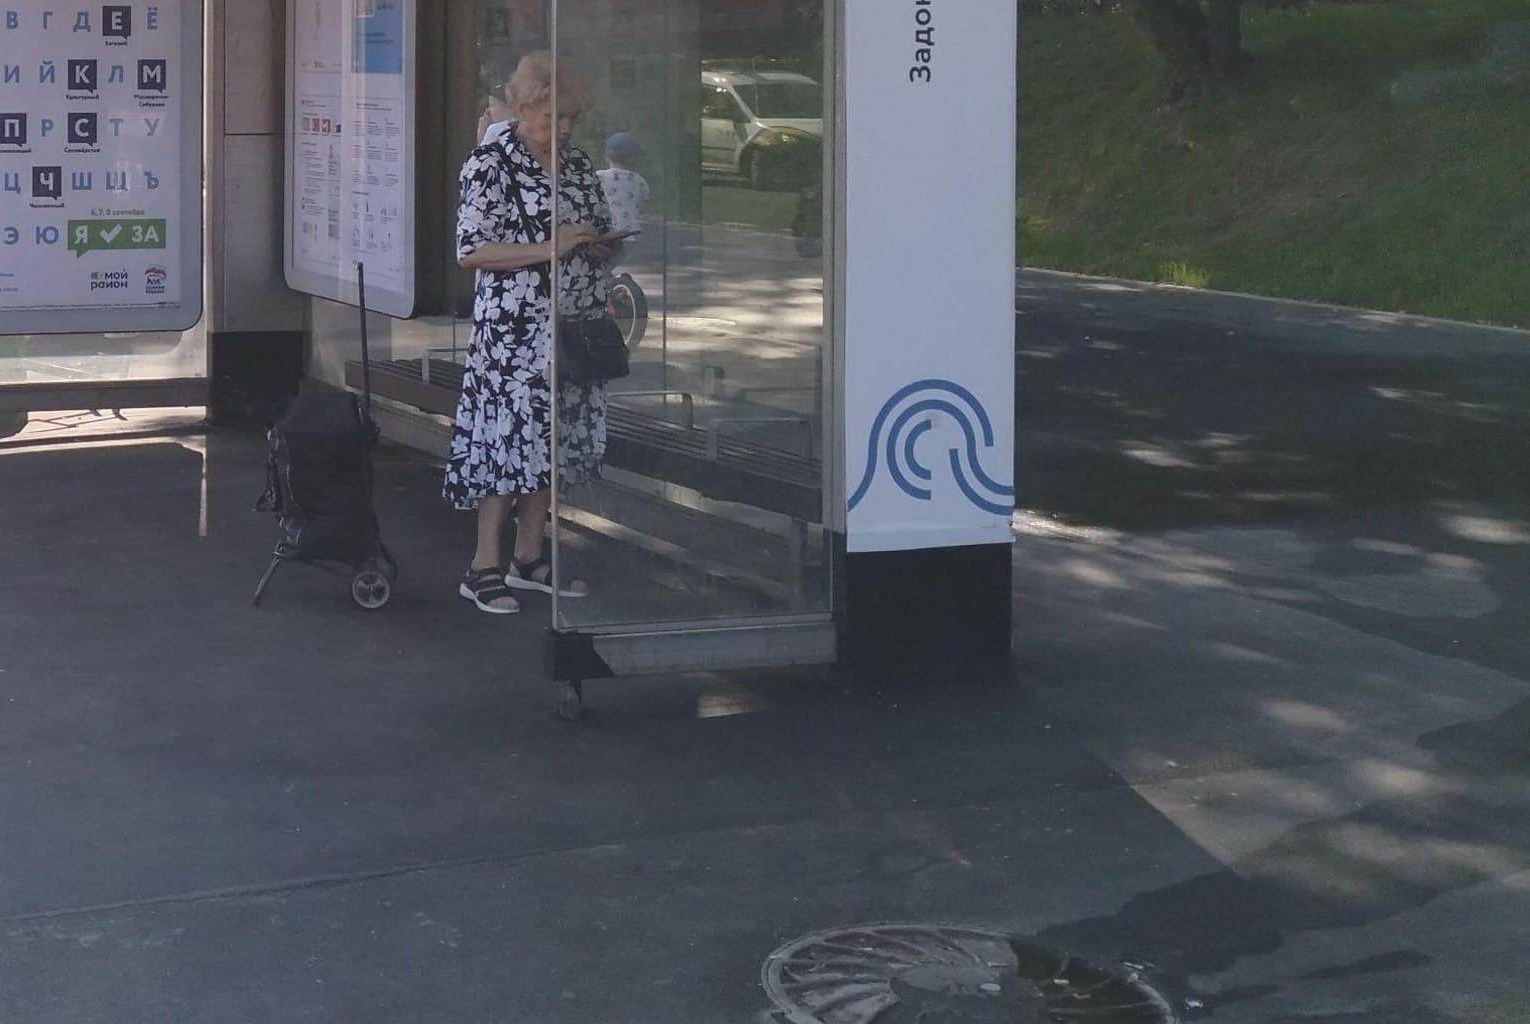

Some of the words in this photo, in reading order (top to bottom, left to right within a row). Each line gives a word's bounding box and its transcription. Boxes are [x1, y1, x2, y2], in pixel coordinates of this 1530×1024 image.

[6, 11, 19, 29] В
[43, 11, 53, 29] Г
[73, 12, 91, 32] Д
[111, 11, 123, 30] Е
[147, 7, 158, 30] Ё
[4, 65, 20, 83] И
[39, 60, 55, 83] Й
[75, 65, 90, 83] К
[109, 65, 123, 83] Л
[142, 65, 161, 83] М
[4, 119, 19, 137] П
[41, 119, 55, 137] Р
[74, 118, 90, 137] С
[109, 118, 124, 136] Т
[144, 118, 160, 136] У
[4, 173, 21, 194] Ц
[39, 172, 54, 191] Ч
[72, 172, 92, 190] Ш
[106, 171, 129, 192] Щ
[143, 171, 159, 190] Ъ
[3, 226, 20, 245] Э
[35, 226, 59, 245] Ю
[74, 225, 88, 244] Я
[132, 225, 159, 242] ЗА
